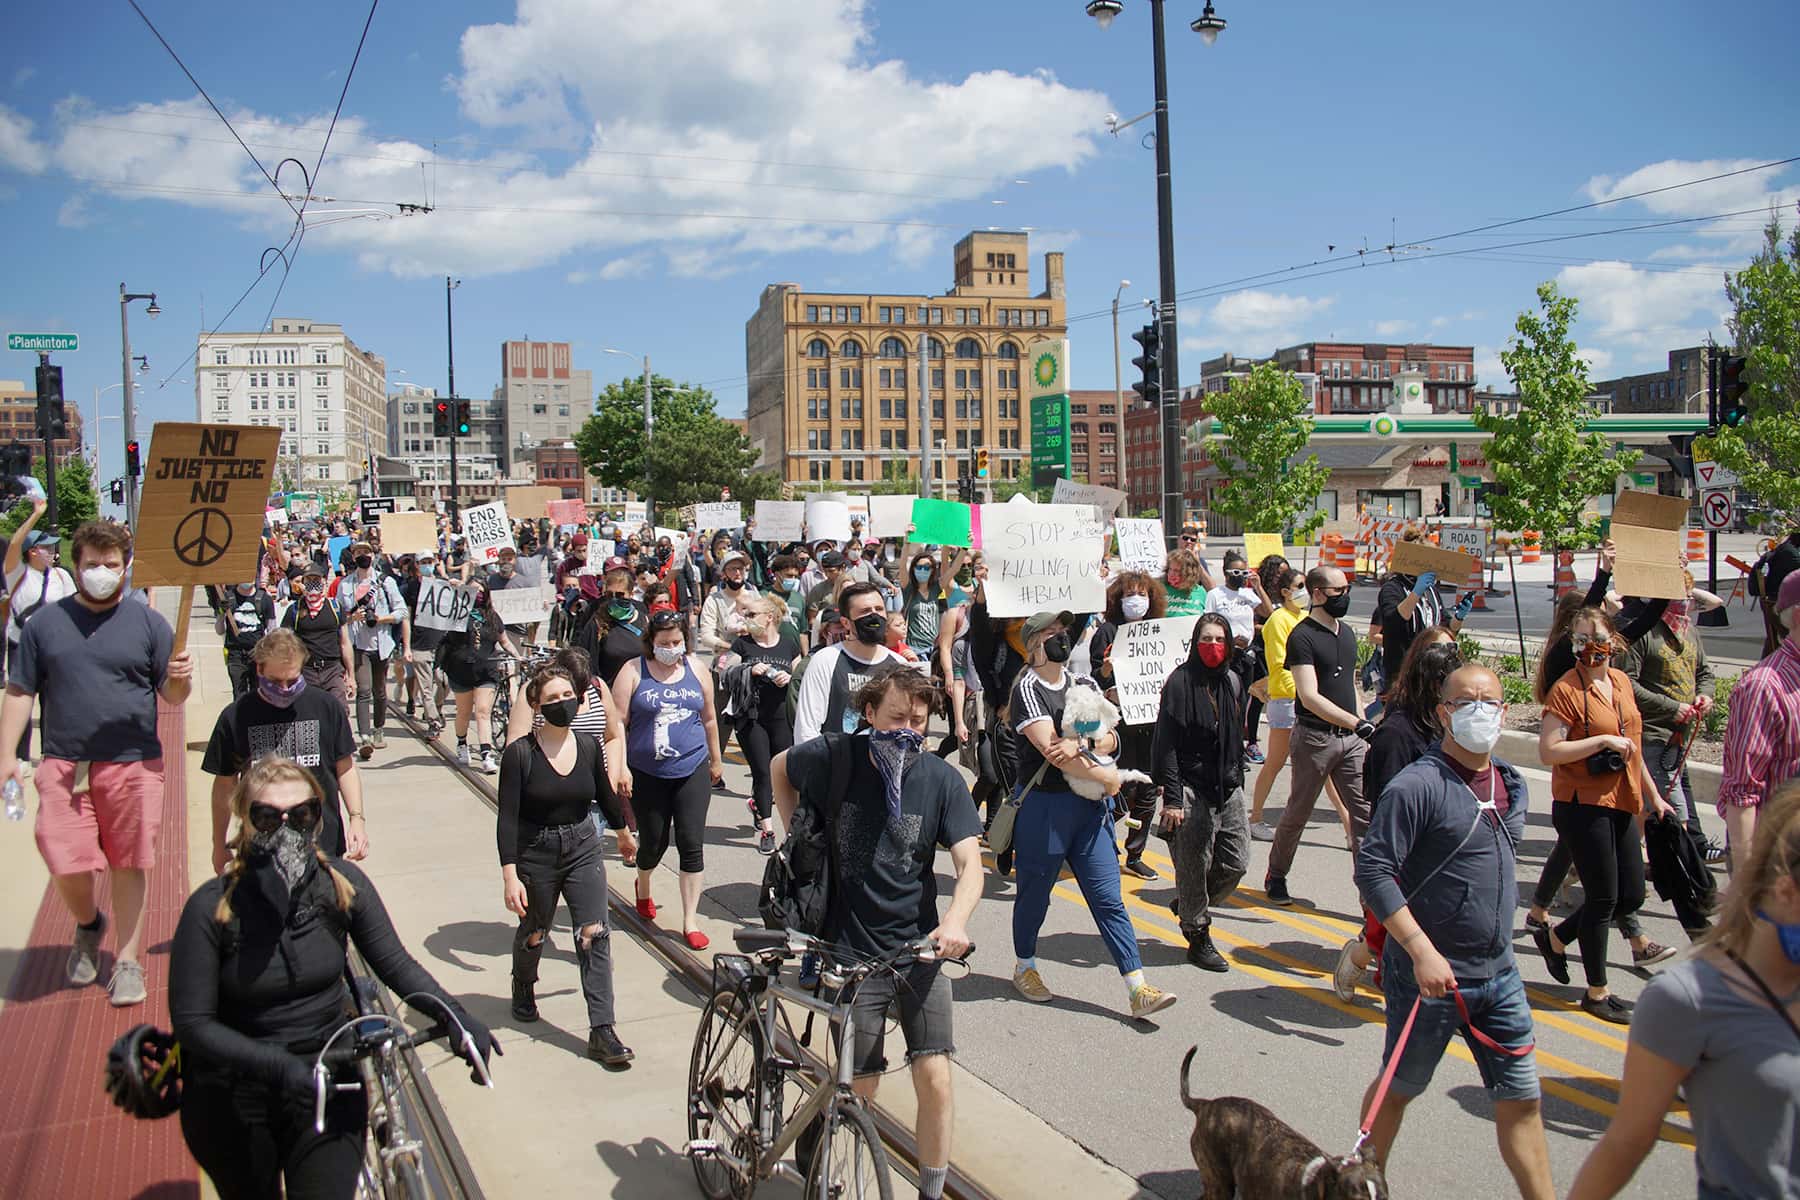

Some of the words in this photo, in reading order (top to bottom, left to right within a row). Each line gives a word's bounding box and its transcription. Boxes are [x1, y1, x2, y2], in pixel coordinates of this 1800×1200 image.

[14, 336, 68, 348] Plankinton
[199, 429, 239, 456] NO
[156, 458, 266, 479] JUSTICE
[190, 480, 229, 504] NO
[469, 507, 496, 524] END
[468, 518, 503, 534] RACIST
[1119, 522, 1153, 538] BLACK
[470, 527, 506, 545] MASS
[1006, 522, 1064, 550] STOP
[1451, 533, 1477, 545] ROAD
[1123, 540, 1159, 558] LIVES
[1002, 559, 1070, 582] KILLING
[421, 585, 470, 621] ACAB
[1018, 585, 1073, 604] #BLM
[1128, 641, 1166, 658] CRIME
[1140, 661, 1164, 676] NOT
